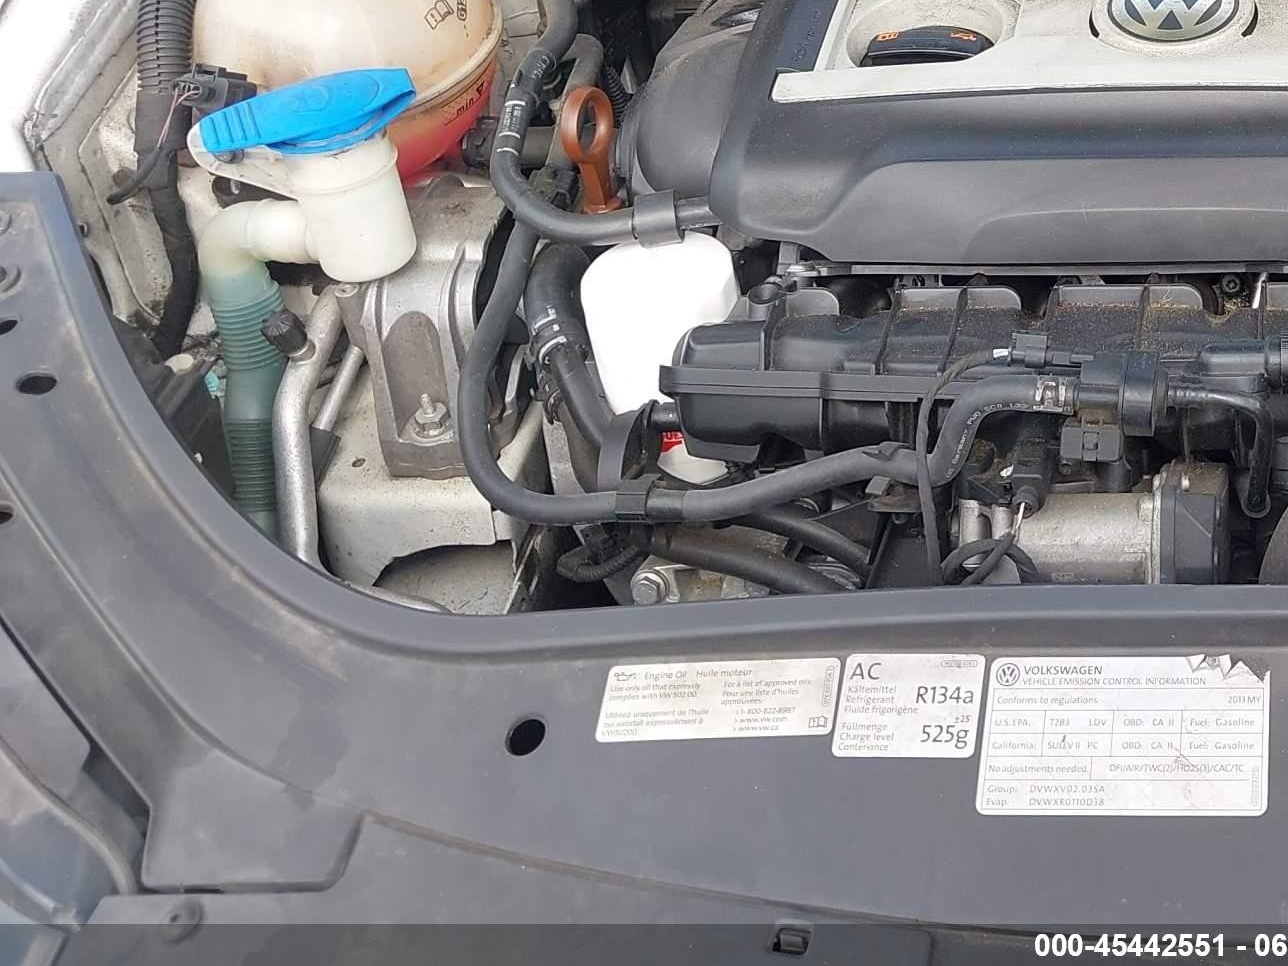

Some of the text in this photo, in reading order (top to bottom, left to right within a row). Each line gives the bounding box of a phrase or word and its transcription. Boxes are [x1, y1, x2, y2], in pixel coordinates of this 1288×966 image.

[456, 97, 474, 115] min
[643, 672, 674, 682] Engine
[696, 669, 719, 678] Huile
[720, 668, 753, 677] moteur
[850, 662, 882, 680] AC
[1023, 666, 1103, 675] VOLKSWAGEN
[652, 682, 668, 691] that
[1022, 678, 1056, 686] VEHICLE
[1058, 678, 1100, 686] EMISSION
[722, 690, 739, 698] Pour
[848, 684, 897, 694] Kältemittel
[915, 686, 974, 704] R134a
[998, 696, 1038, 704] Conforms
[1040, 696, 1048, 704] to
[1228, 696, 1246, 704] 2013
[1248, 696, 1261, 704] MY
[846, 696, 895, 706] Refrigerant
[844, 706, 919, 716] Fluide frigorigène
[842, 722, 888, 732] Füllmenge
[1089, 718, 1107, 726] LDV
[1152, 718, 1164, 726] CA
[1190, 718, 1210, 726] Fuel:
[1216, 718, 1255, 726] Gasoline
[840, 732, 895, 744] Charge level
[920, 724, 970, 750] 525g
[838, 742, 889, 752] Contenance
[1087, 742, 1098, 750] PC
[1150, 742, 1162, 750] CA
[1189, 742, 1209, 750] Fuel:
[1214, 742, 1254, 750] Gasoline
[988, 764, 1000, 772] No
[1002, 764, 1054, 775] adjustments
